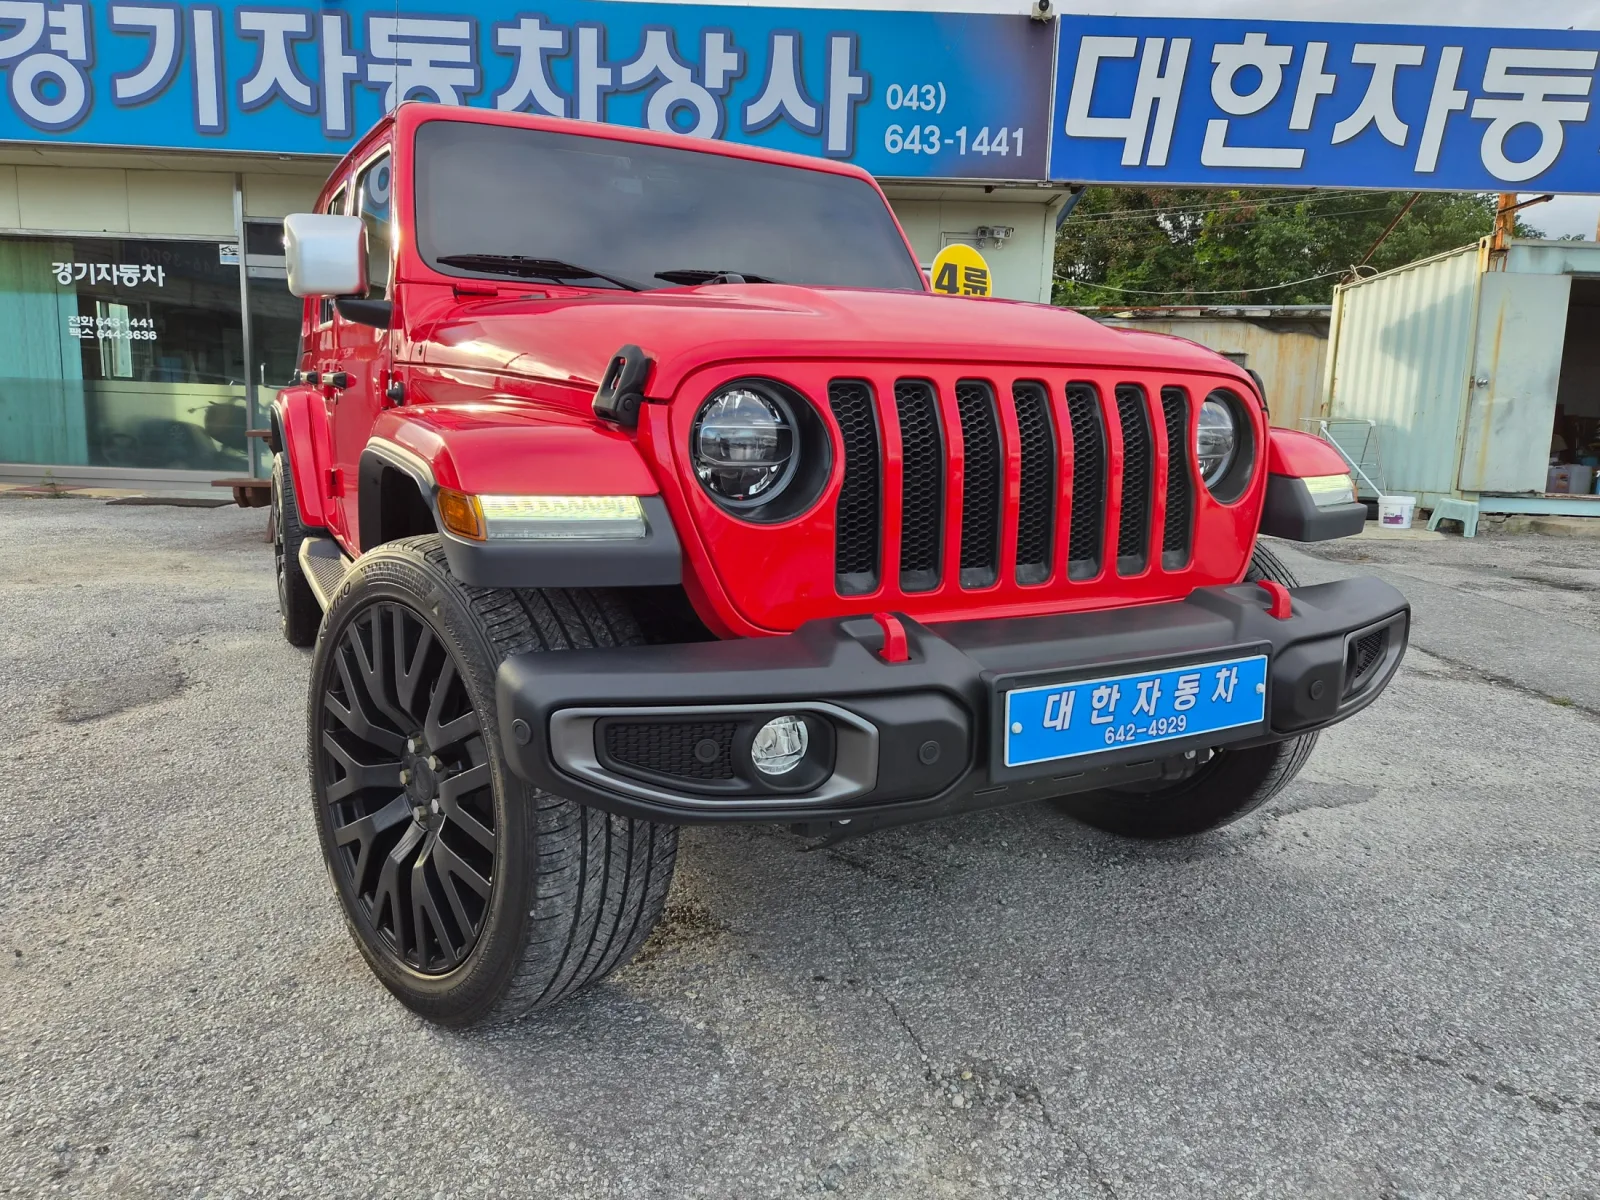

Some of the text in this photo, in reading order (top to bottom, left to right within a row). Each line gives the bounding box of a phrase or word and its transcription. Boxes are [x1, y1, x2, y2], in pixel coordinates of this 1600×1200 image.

[885, 81, 947, 112] 043)
[1064, 32, 1600, 182] 대한자동
[884, 124, 1025, 157] 643-1441
[51, 262, 165, 287] 경기자동차
[68, 315, 154, 328] 전화 643-1441
[96, 329, 157, 340] 644-3636
[1104, 714, 1188, 745] 642-4929
